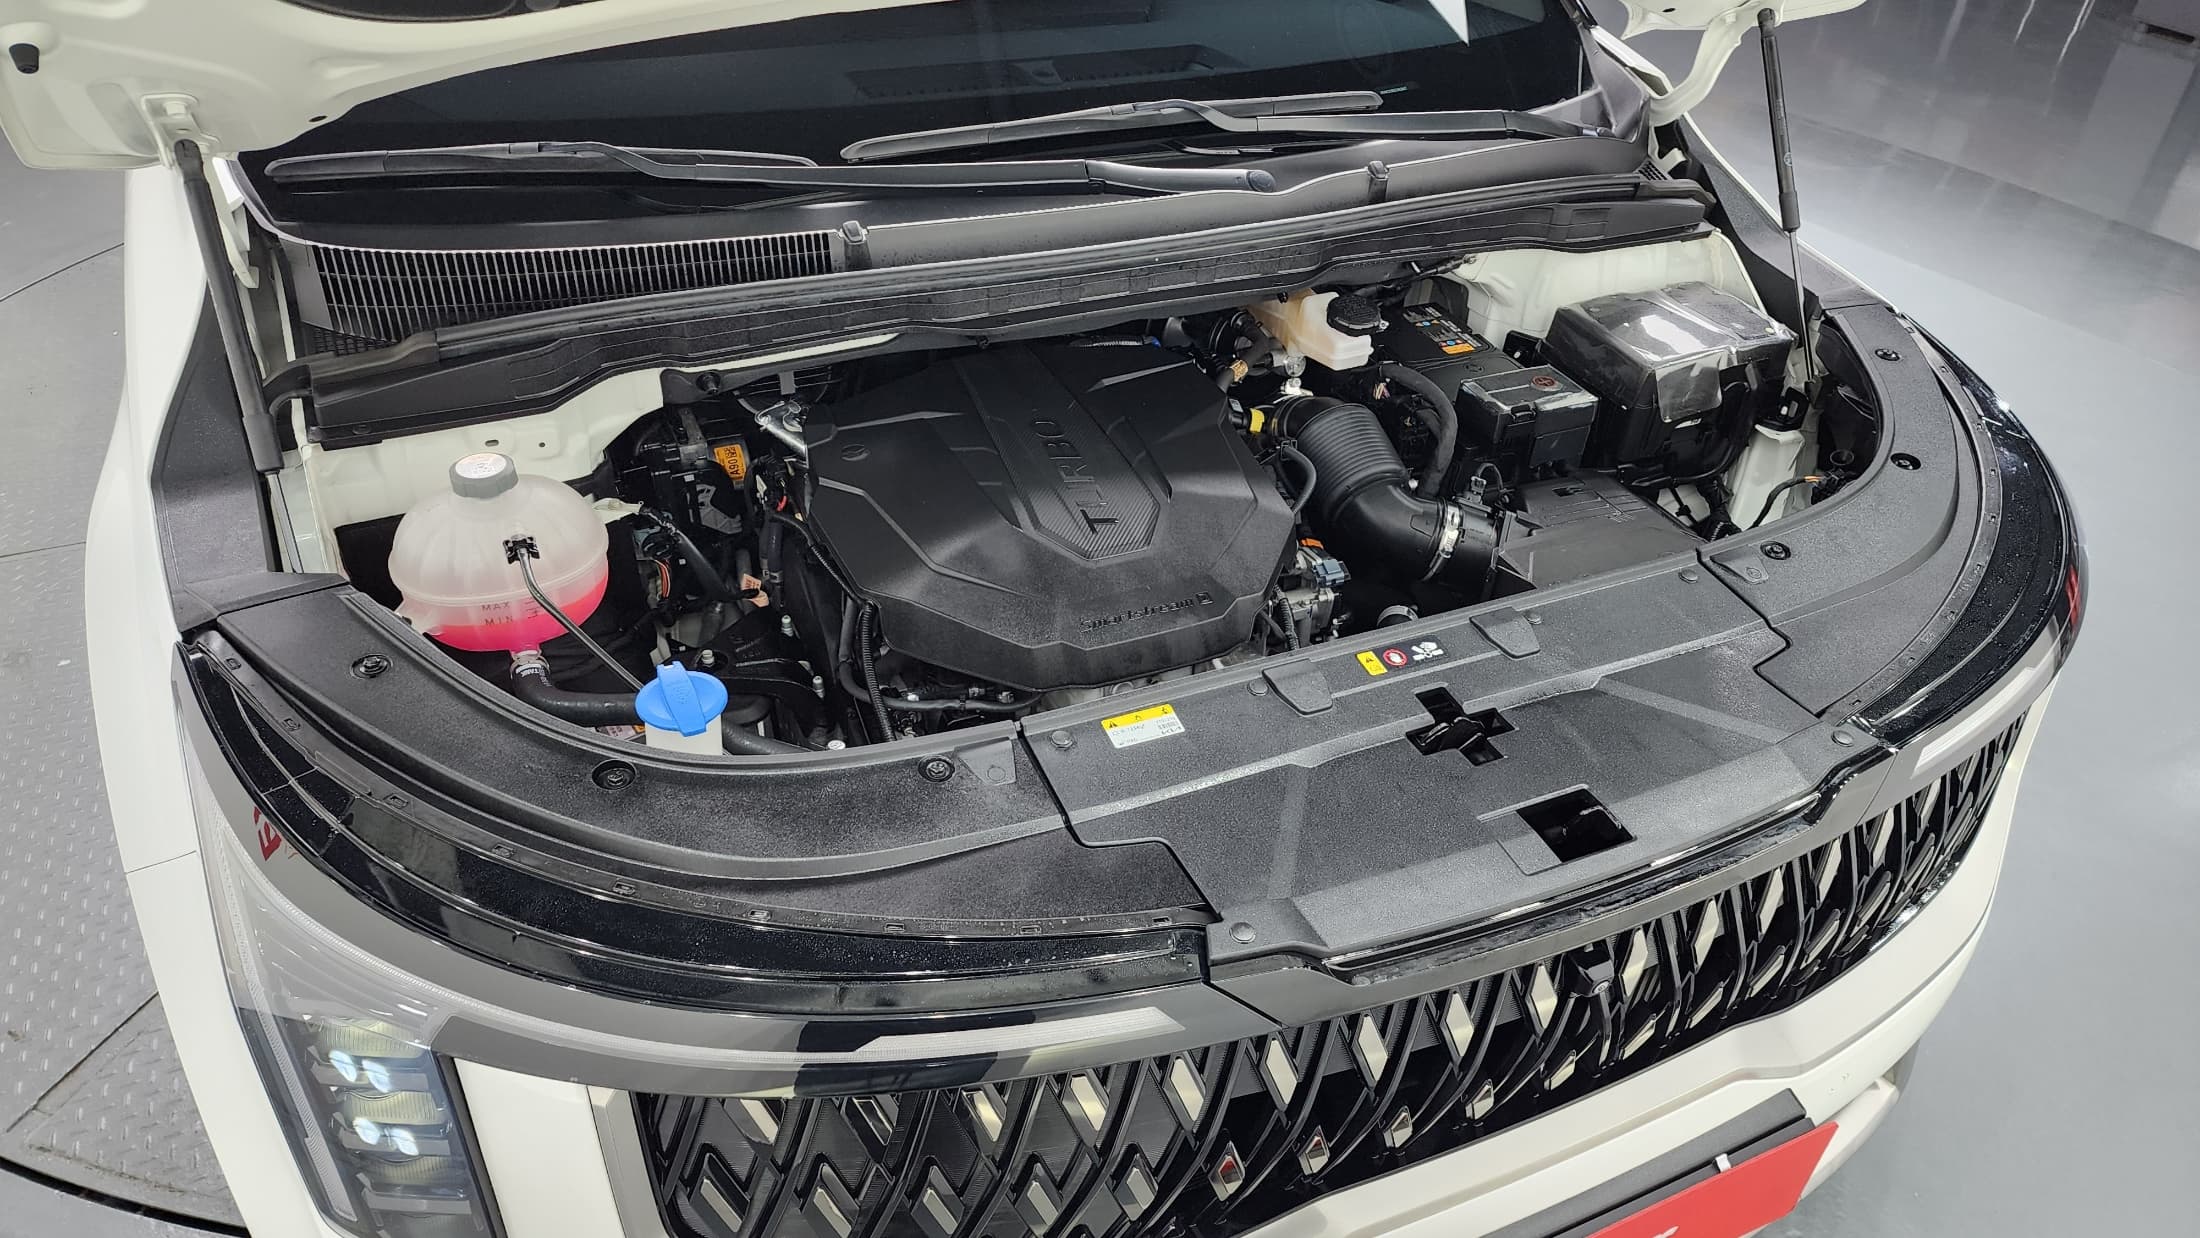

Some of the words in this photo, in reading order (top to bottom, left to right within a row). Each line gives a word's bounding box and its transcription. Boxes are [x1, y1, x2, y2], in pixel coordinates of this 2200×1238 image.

[1035, 420, 1119, 534] TURBO
[482, 601, 511, 611] MAX
[1079, 597, 1195, 633] Smartstream
[484, 616, 513, 626] MIN
